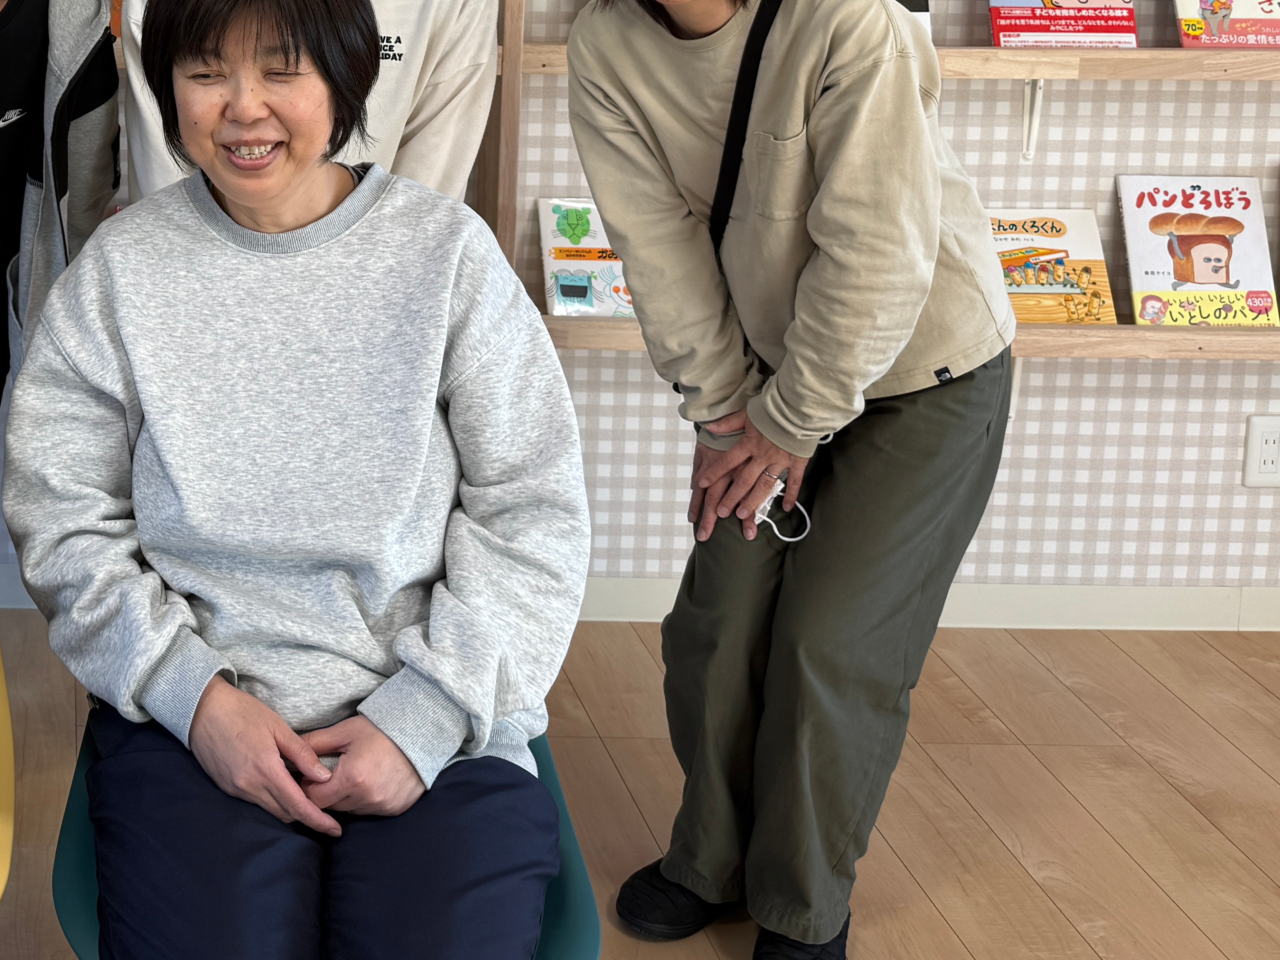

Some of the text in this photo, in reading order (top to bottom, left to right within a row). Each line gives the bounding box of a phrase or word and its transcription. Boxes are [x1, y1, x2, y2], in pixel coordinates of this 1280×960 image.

[1184, 24, 1198, 32] 70
[1136, 185, 1251, 210] パンどろぼう
[1021, 221, 1062, 234] くろくん
[1247, 297, 1263, 307] 430
[1169, 305, 1271, 326] いとしのパン!
